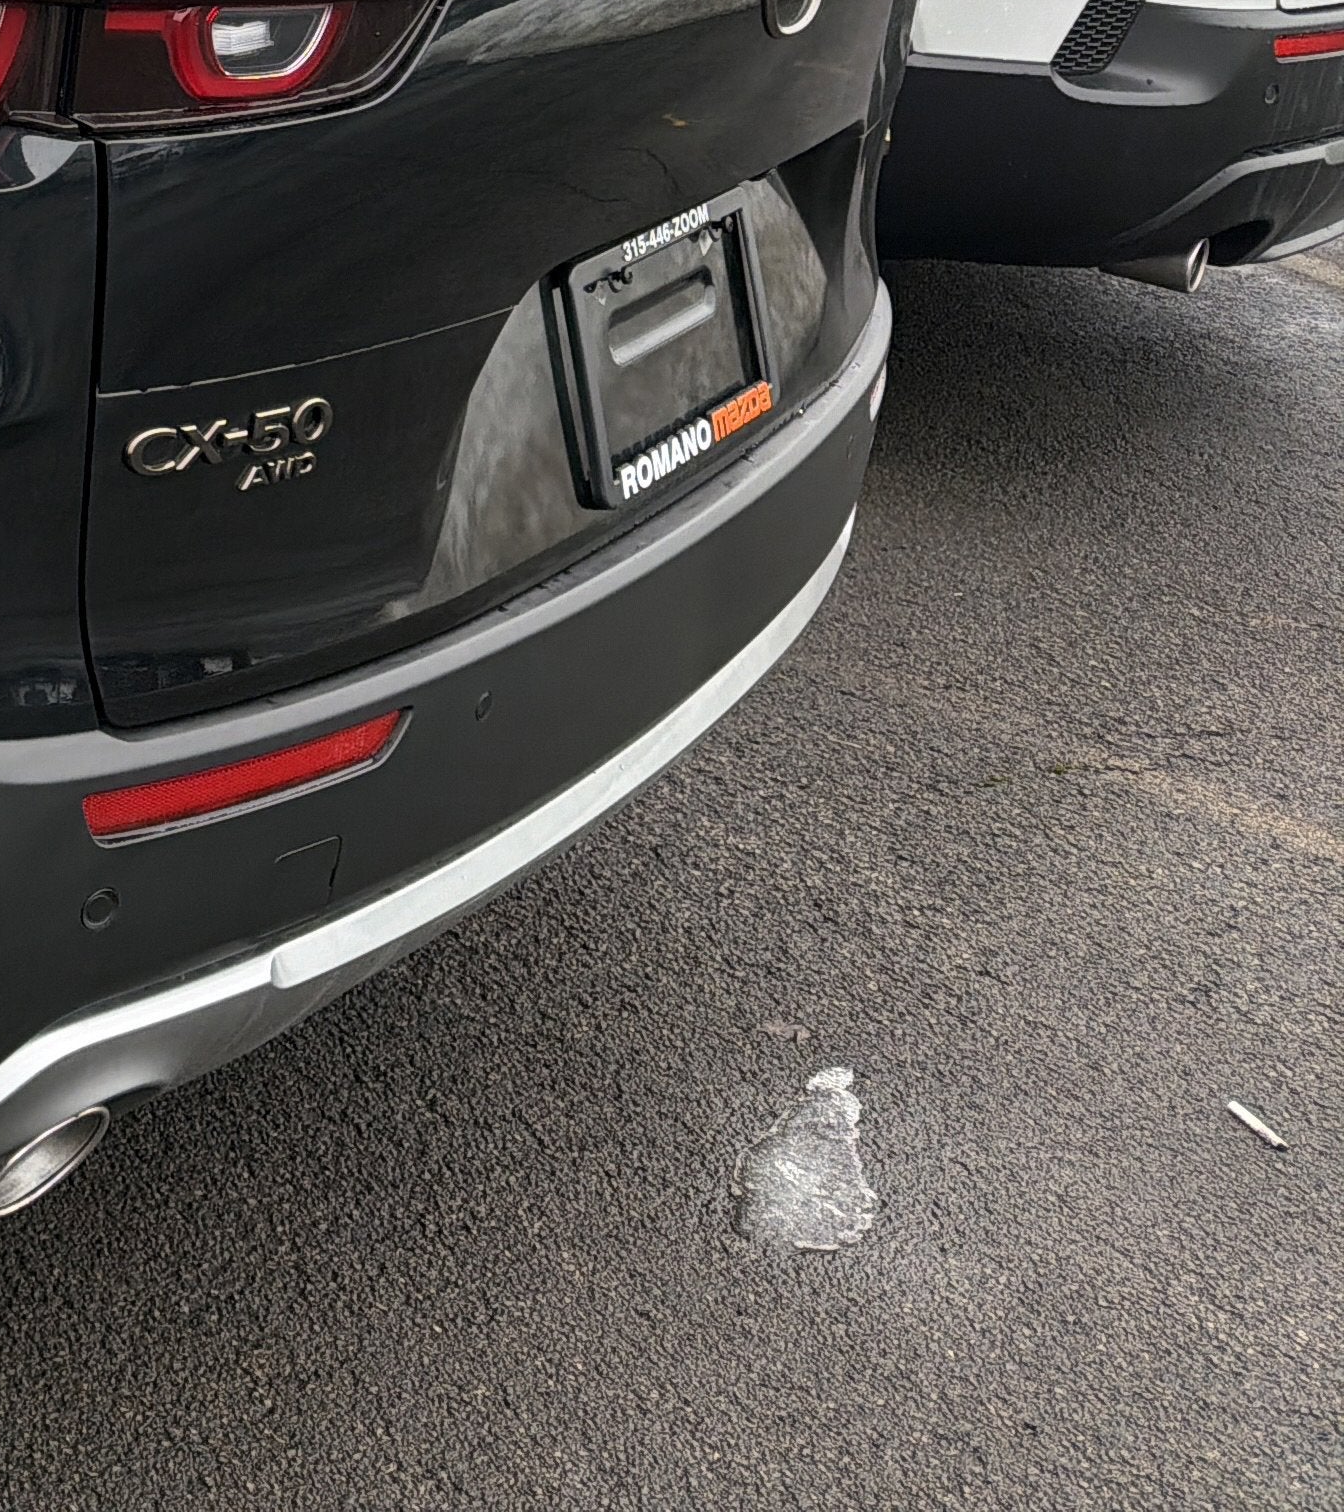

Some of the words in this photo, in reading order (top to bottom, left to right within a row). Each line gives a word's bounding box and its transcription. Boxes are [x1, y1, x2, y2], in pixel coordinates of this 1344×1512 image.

[621, 203, 711, 262] 315-446-ZOOM
[122, 397, 334, 477] CX-50
[235, 451, 317, 491] AWD
[618, 417, 712, 500] ROMANO
